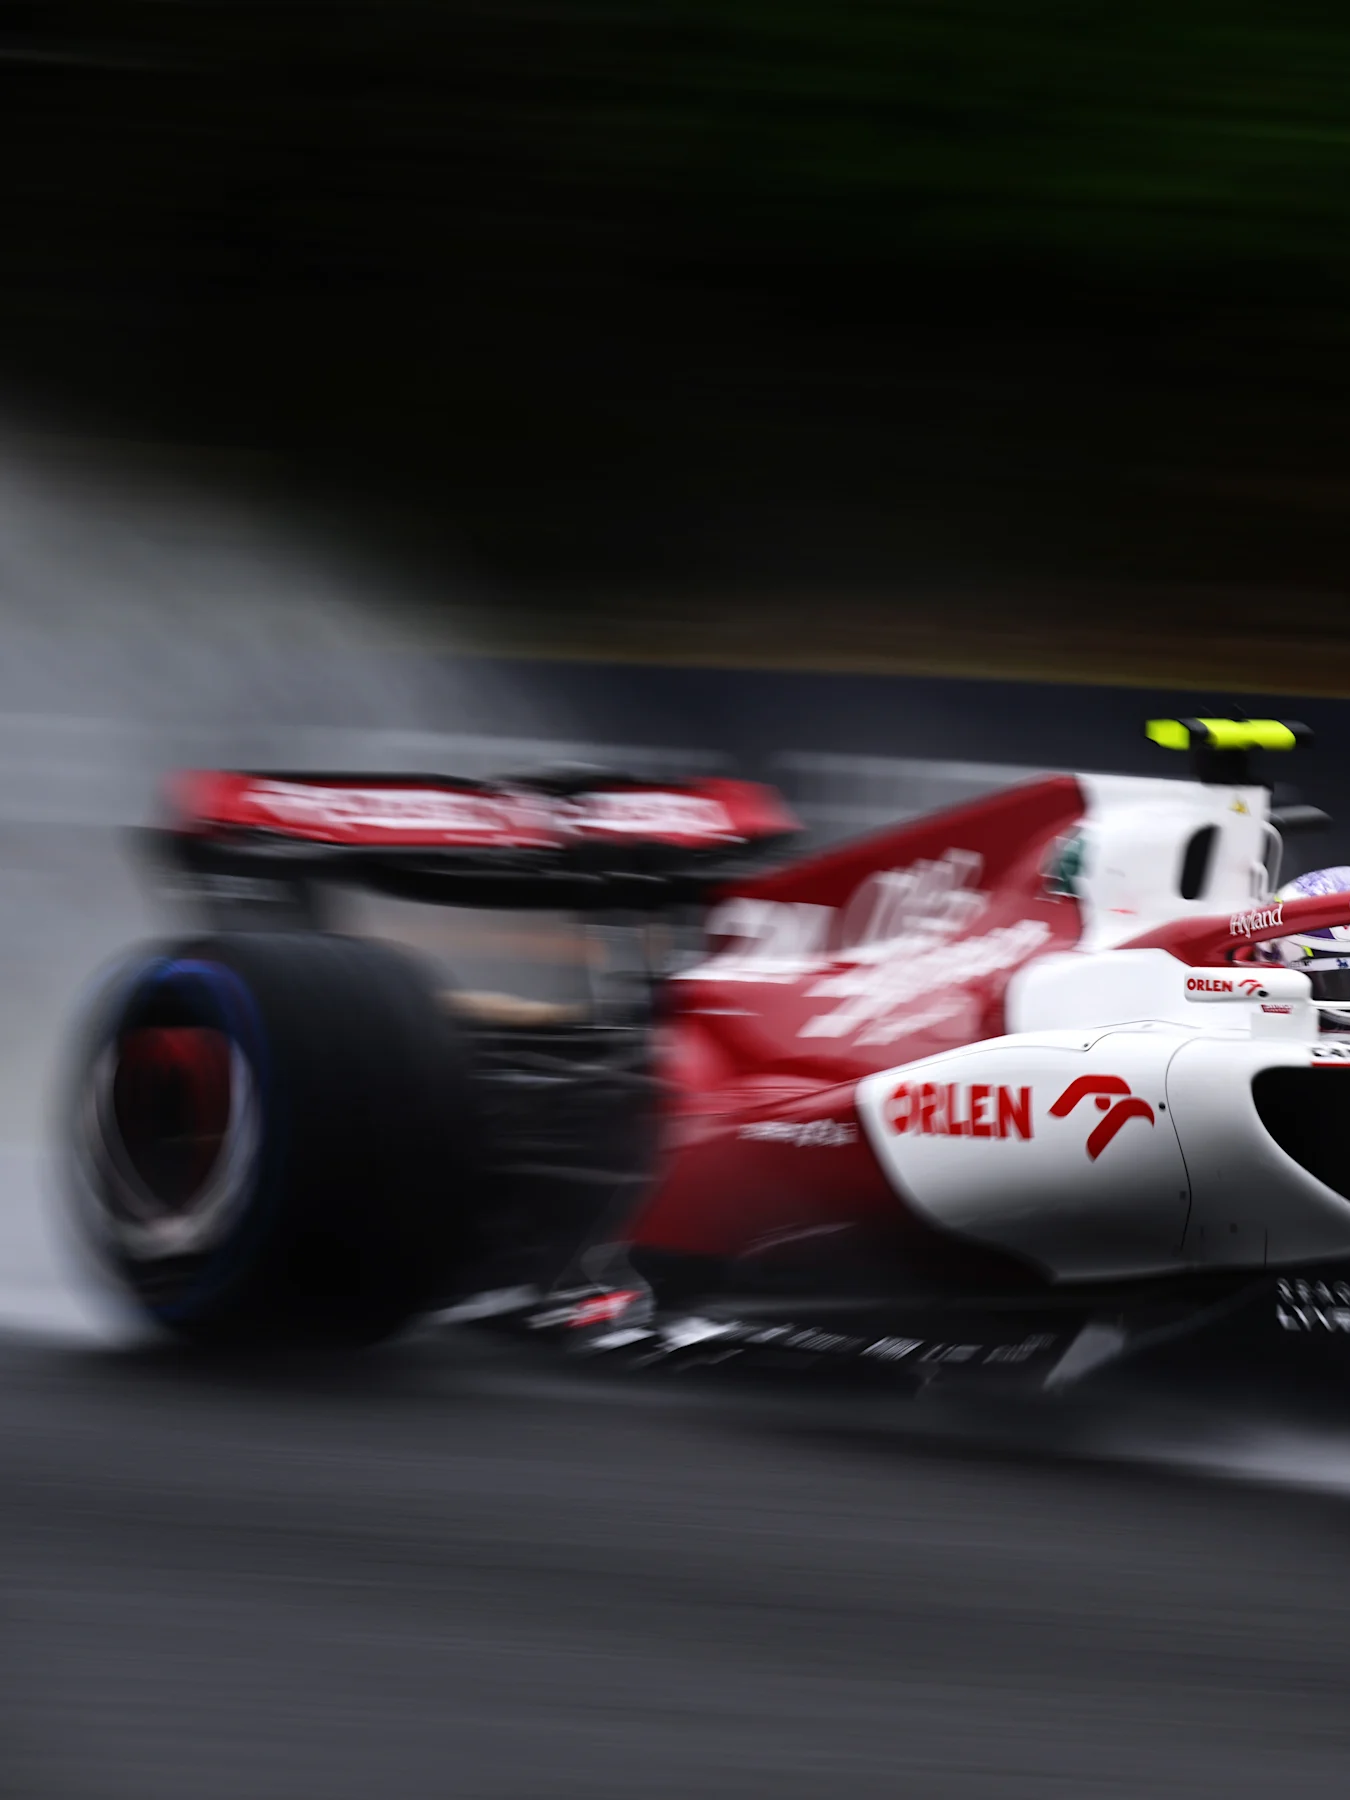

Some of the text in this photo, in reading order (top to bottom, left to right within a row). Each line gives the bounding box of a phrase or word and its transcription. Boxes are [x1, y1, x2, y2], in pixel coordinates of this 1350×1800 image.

[1229, 903, 1284, 938] Hyland
[1186, 978, 1234, 993] ORLEN
[883, 1081, 1034, 1142] ORLEN
